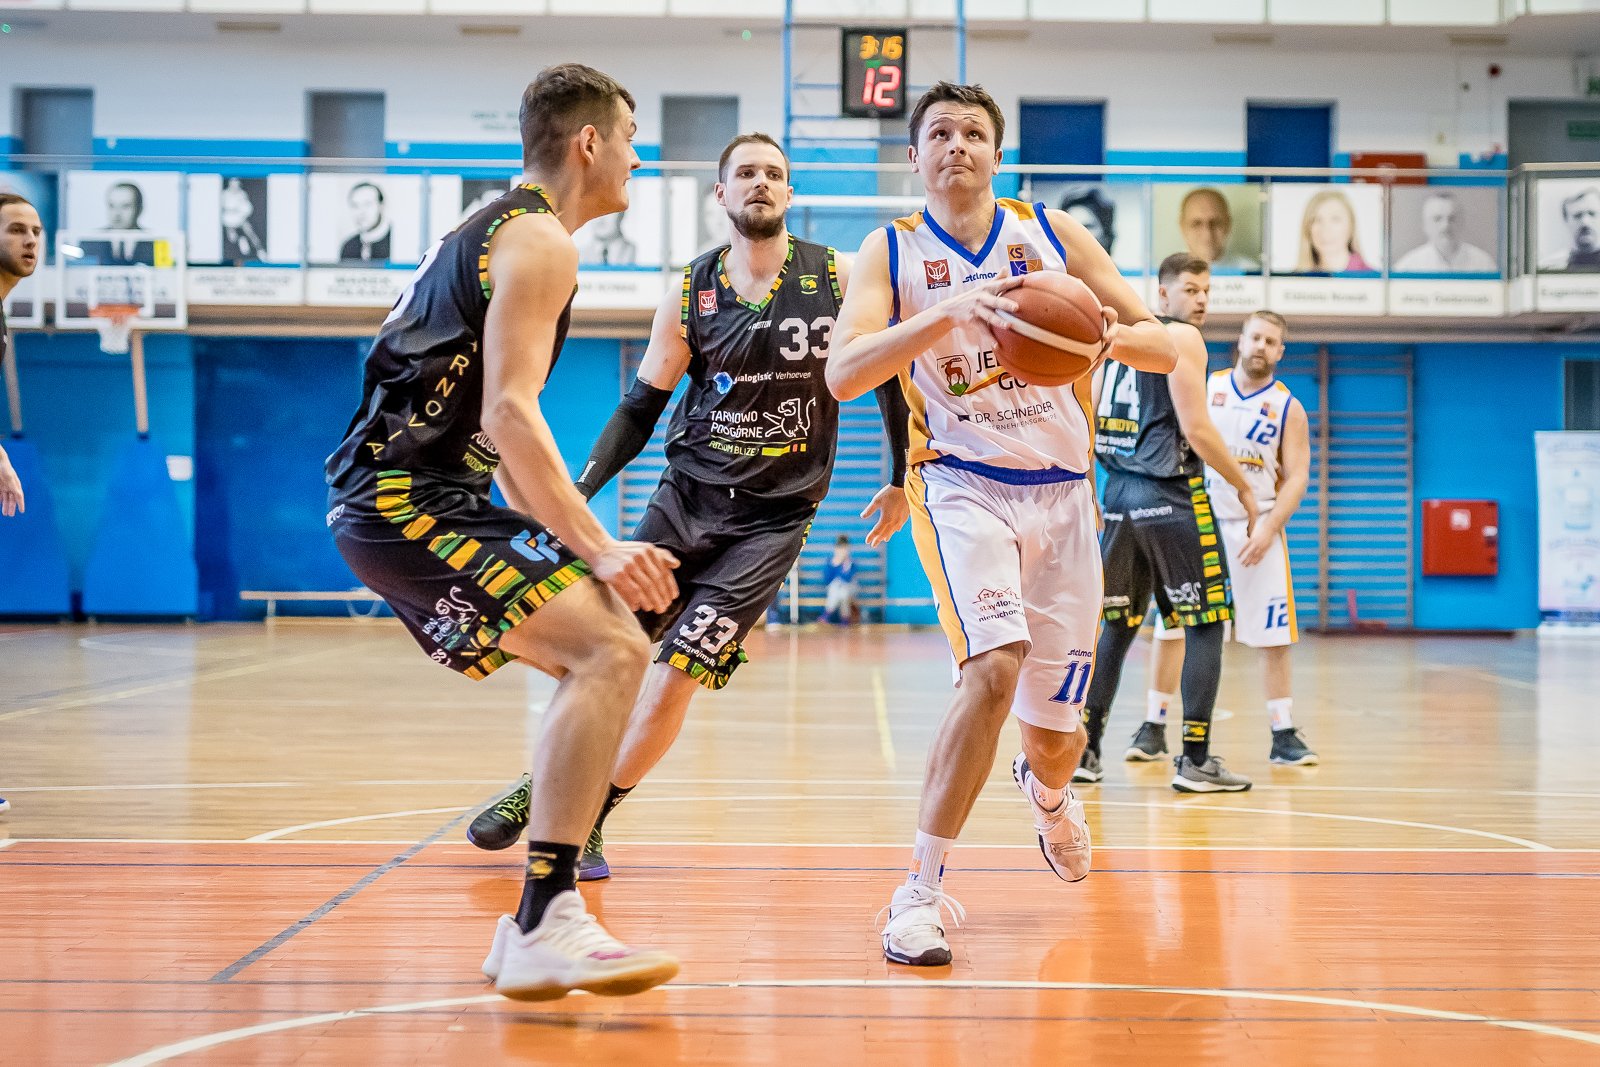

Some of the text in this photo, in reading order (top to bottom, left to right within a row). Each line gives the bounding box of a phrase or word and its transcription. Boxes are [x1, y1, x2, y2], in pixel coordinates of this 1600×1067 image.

[862, 65, 902, 108] 12
[1009, 247, 1024, 259] KS
[779, 316, 835, 361] 33
[775, 371, 812, 381] Verhoeven
[1097, 360, 1140, 421] 14
[710, 410, 758, 424] TARNOWO
[975, 400, 1054, 424] DR. SCHNEIDER
[710, 422, 764, 439] PODGÓRNE
[1246, 420, 1278, 446] 12
[1265, 603, 1289, 629] 12
[679, 604, 739, 655] 33
[1048, 660, 1092, 705] 11
